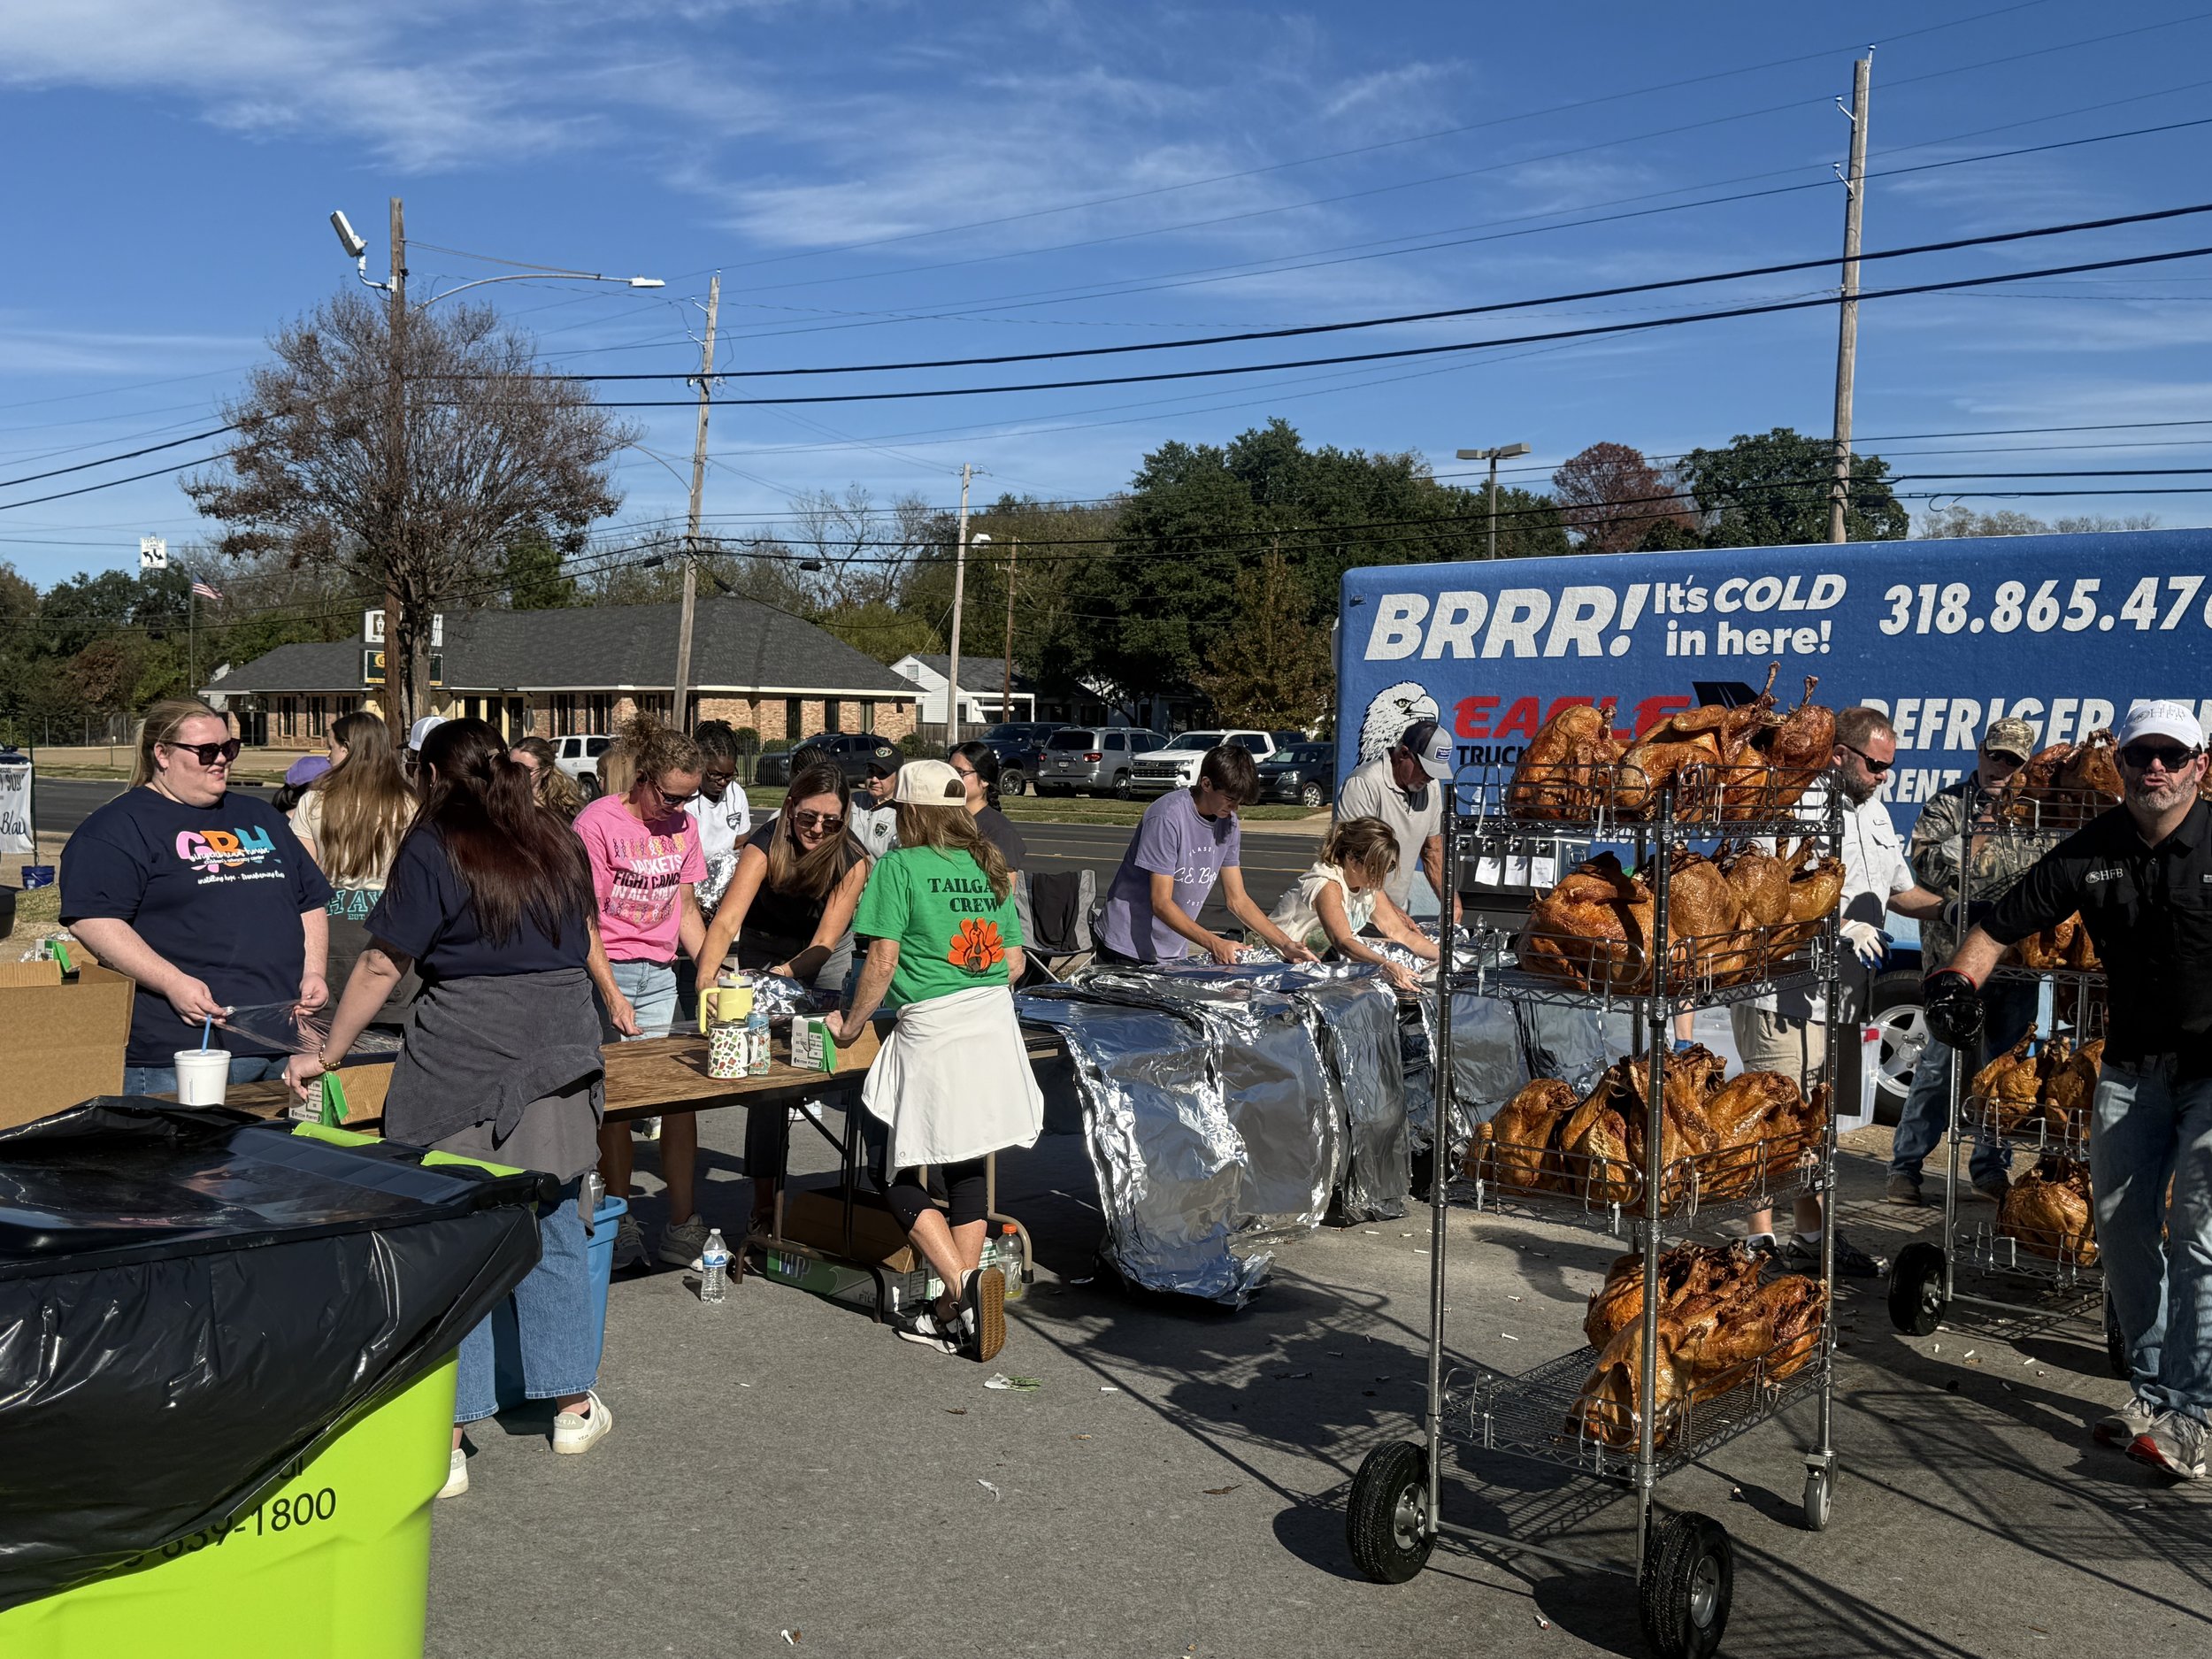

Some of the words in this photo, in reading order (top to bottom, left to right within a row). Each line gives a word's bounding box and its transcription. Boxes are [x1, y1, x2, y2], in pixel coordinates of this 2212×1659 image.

[1655, 575, 1709, 614] It's
[1713, 573, 1847, 613] COLD
[1879, 575, 2212, 635] 318.865.47
[1363, 583, 1651, 661] BRRR!
[1666, 619, 1707, 657] in
[1717, 619, 1832, 656] here!
[1456, 745, 1527, 765] TRUC
[630, 854, 683, 875] JACKETS
[2100, 868, 2123, 880] HFB
[612, 871, 649, 890] FIGHT
[611, 885, 627, 899] IN
[626, 887, 649, 902] ALL
[949, 897, 997, 912] CREW
